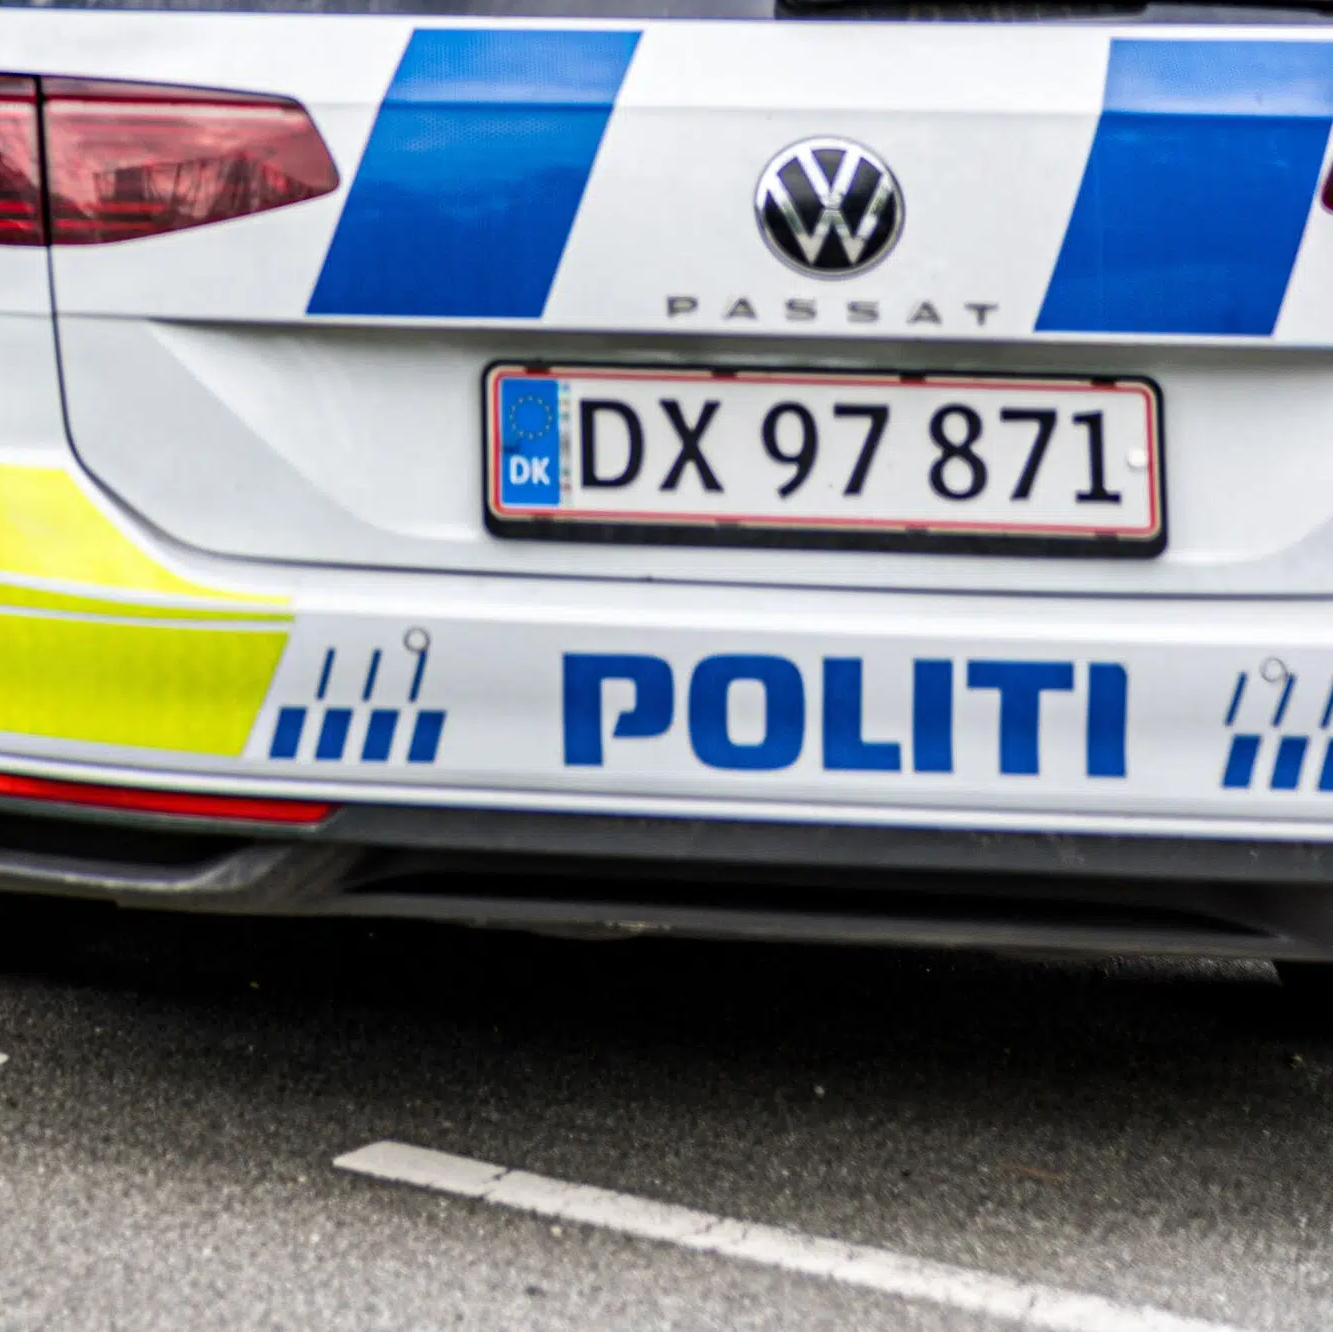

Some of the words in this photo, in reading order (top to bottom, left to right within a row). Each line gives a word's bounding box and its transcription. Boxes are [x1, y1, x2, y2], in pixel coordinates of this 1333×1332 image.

[665, 295, 1000, 326] PASSAT
[509, 454, 551, 486] DK
[579, 399, 724, 493] DX
[760, 401, 891, 499] 97
[928, 403, 1123, 504] 871
[560, 652, 1130, 780] POLITI
